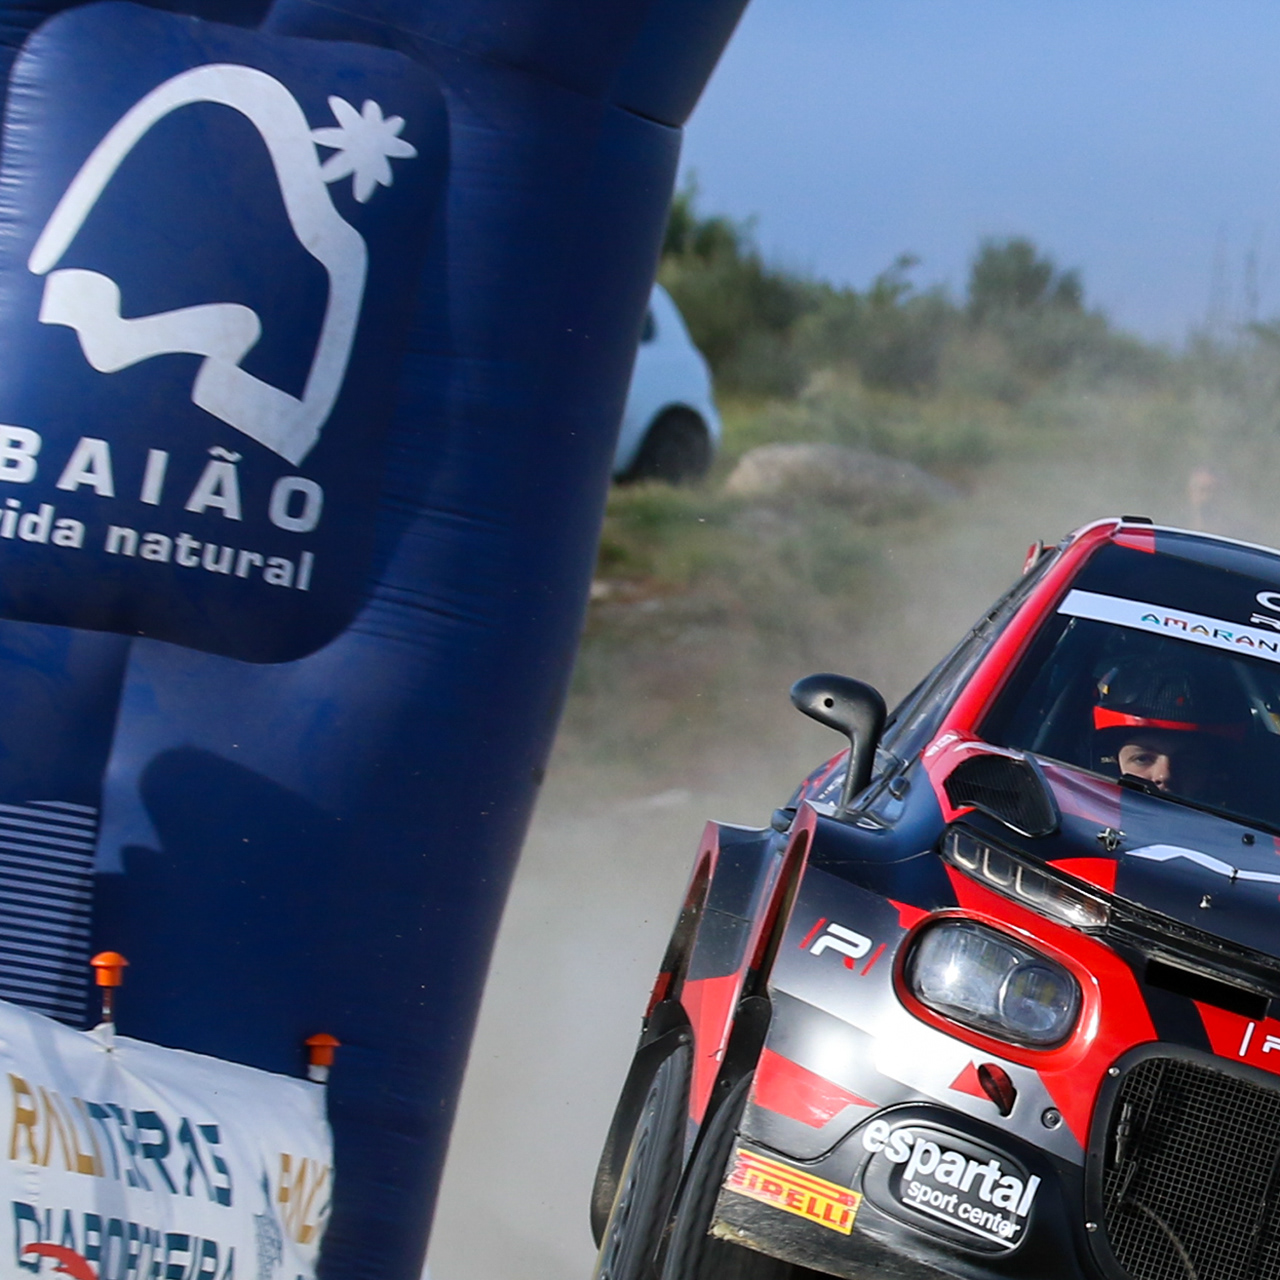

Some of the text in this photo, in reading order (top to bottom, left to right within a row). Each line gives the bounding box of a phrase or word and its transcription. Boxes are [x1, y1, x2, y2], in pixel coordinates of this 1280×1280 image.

[0, 424, 325, 532] BAIÃO
[0, 498, 314, 591] ida natural
[730, 1151, 857, 1229] PIRELLI
[861, 1119, 1041, 1218] espartal
[906, 1180, 1021, 1239] sport center
